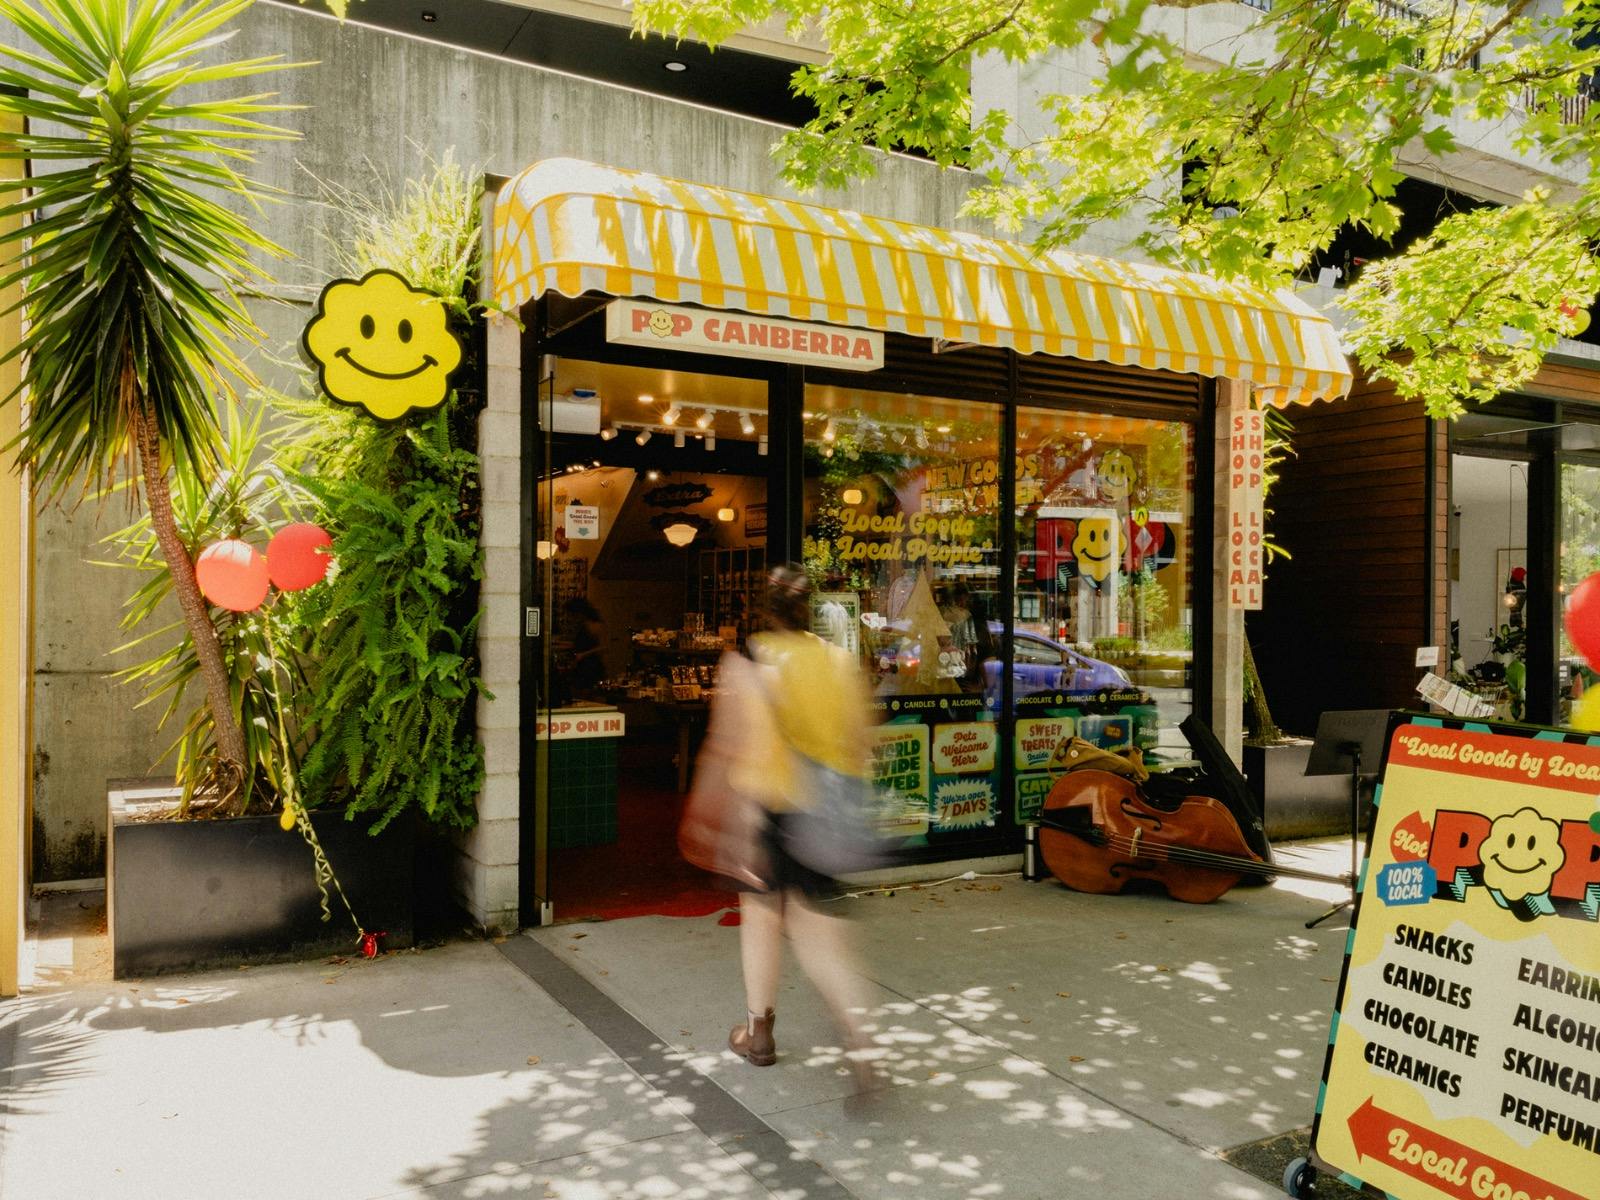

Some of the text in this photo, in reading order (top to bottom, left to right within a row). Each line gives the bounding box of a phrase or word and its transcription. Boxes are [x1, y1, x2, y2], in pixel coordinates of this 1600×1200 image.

[703, 318, 874, 361] CANBERRA
[925, 454, 1038, 491] NEW GODS
[1230, 415, 1245, 605] SHOP LOCAL
[1247, 415, 1262, 605] SHOP LOCAL
[909, 512, 975, 537] Goods
[837, 535, 903, 561] Local
[904, 700, 936, 709] CANDLES
[951, 699, 982, 707] ALCOHOL
[1015, 696, 1052, 704] CHOCOLATE
[1109, 693, 1139, 701] CERAMICS
[536, 719, 621, 735] POP ON IN
[953, 730, 977, 743] Pets
[1029, 723, 1063, 737] SWEET
[941, 741, 989, 756] Welcome
[1021, 738, 1056, 752] TREATS
[951, 754, 978, 767] Here
[1459, 744, 1518, 769] Goods
[1519, 752, 1544, 778] by
[941, 798, 987, 819] 7 DAYS
[1393, 829, 1428, 858] Hot
[1387, 866, 1424, 886] 100%
[1388, 882, 1424, 901] LOCAL
[1394, 924, 1475, 966] SNACKS
[1382, 962, 1473, 1010] CANDLES
[1363, 998, 1480, 1058] CHOCOLATE
[1513, 1003, 1600, 1053] ALCOH
[1363, 1041, 1462, 1098] CERAMICS
[1387, 1128, 1468, 1187] Local
